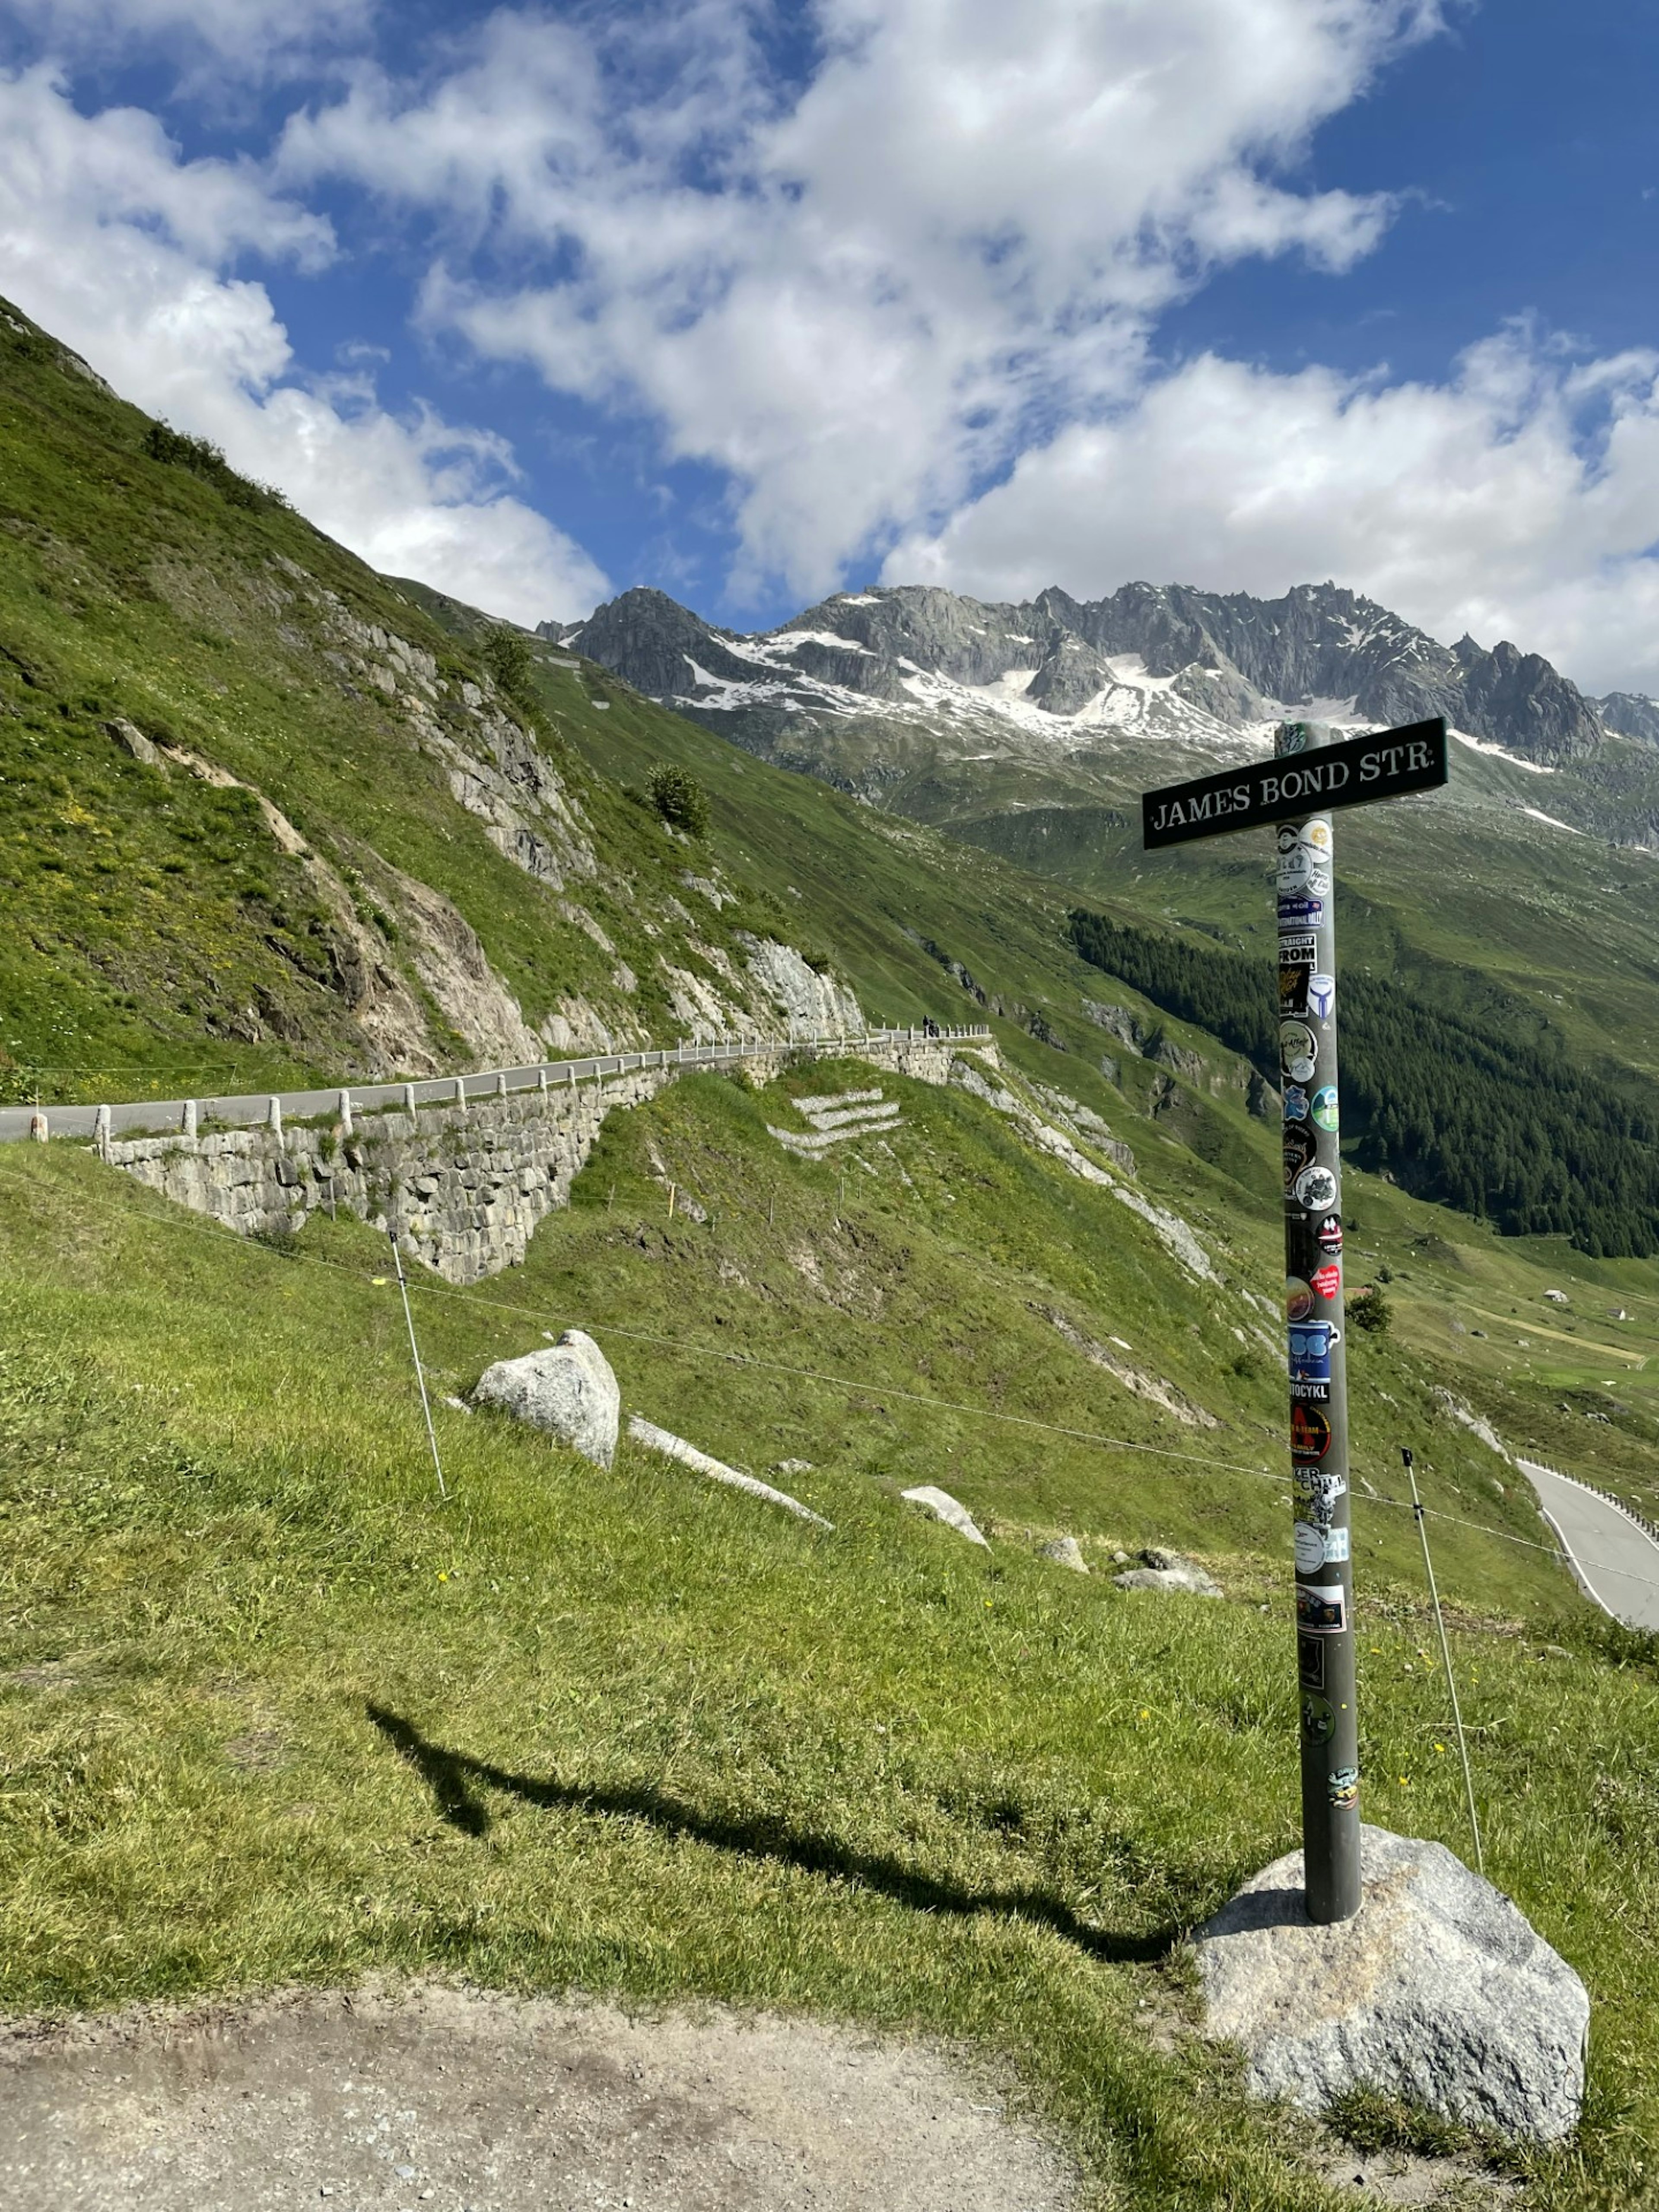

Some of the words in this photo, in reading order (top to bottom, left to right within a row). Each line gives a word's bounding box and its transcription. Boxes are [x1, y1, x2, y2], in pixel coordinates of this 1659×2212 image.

[1154, 785, 1250, 830] JAMES
[1260, 762, 1349, 806] BOND
[1360, 741, 1435, 782] STR.
